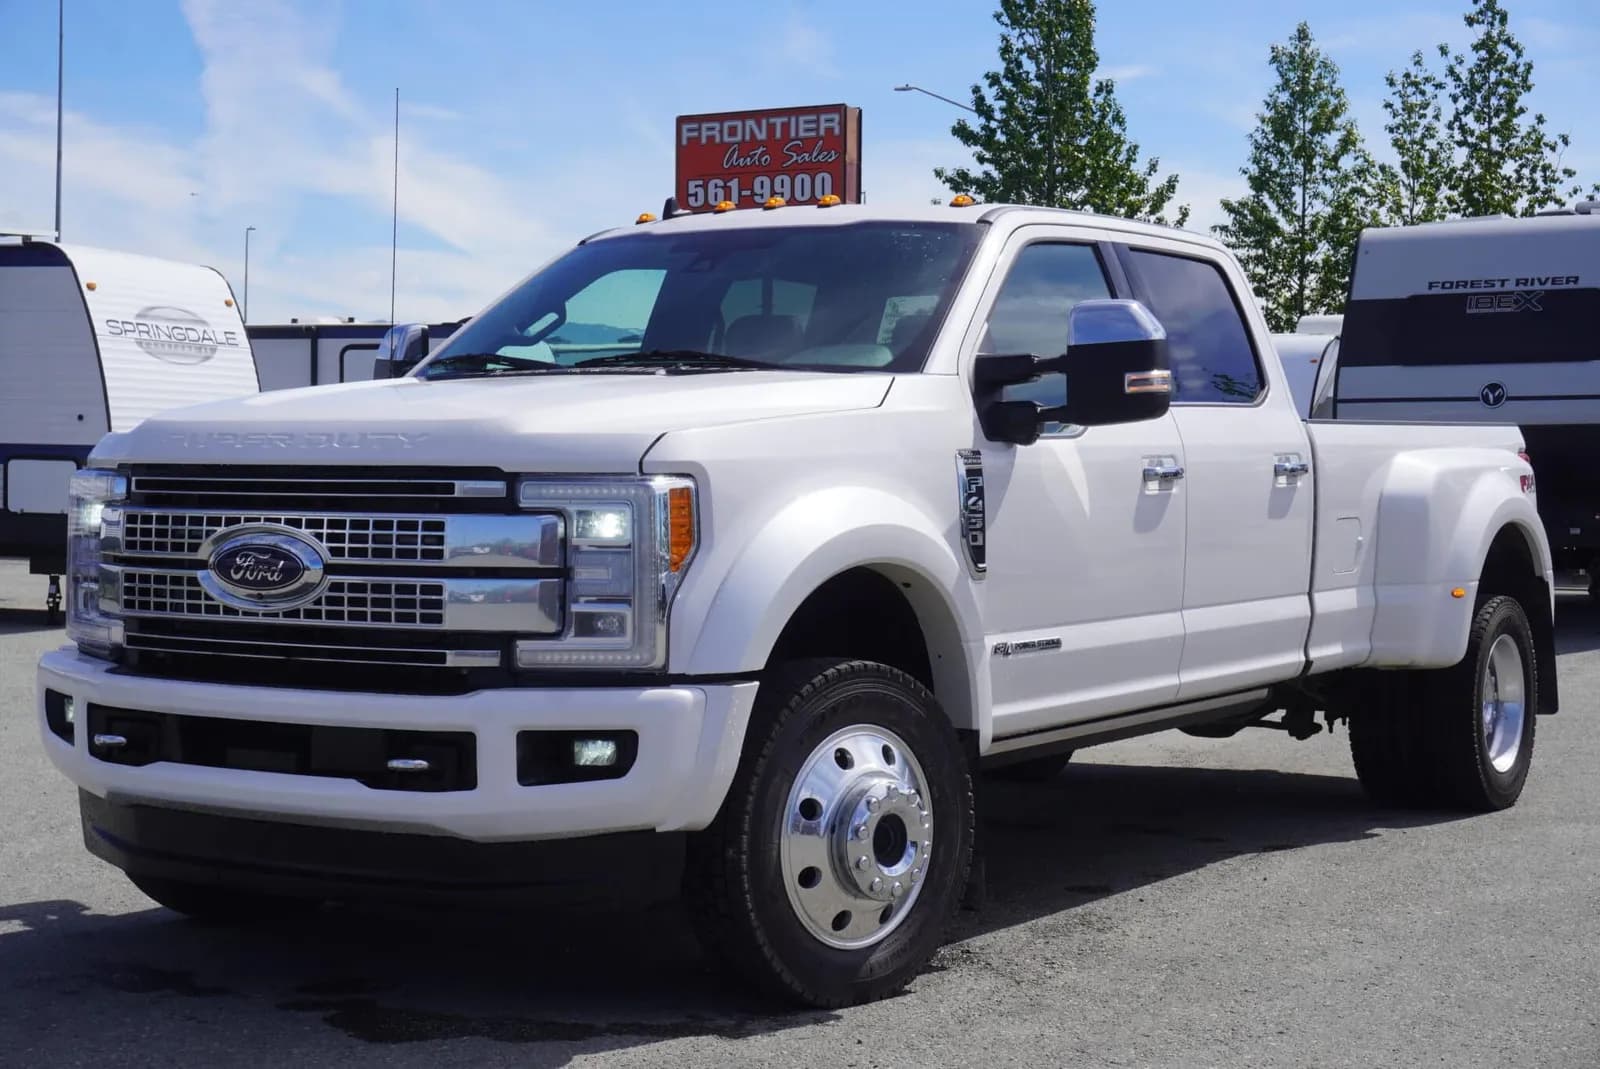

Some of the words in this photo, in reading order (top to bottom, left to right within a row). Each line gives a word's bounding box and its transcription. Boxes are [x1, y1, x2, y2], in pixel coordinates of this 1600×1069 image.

[680, 112, 841, 146] FRONTIER
[723, 144, 771, 169] Auto
[782, 140, 839, 168] Sales
[687, 172, 833, 208] 561-9900
[1428, 279, 1510, 291] FOREST
[1515, 275, 1580, 288] RIVER
[1466, 291, 1544, 314] IBEX
[105, 319, 239, 347] SPRINGDALE
[230, 551, 285, 581] Ford
